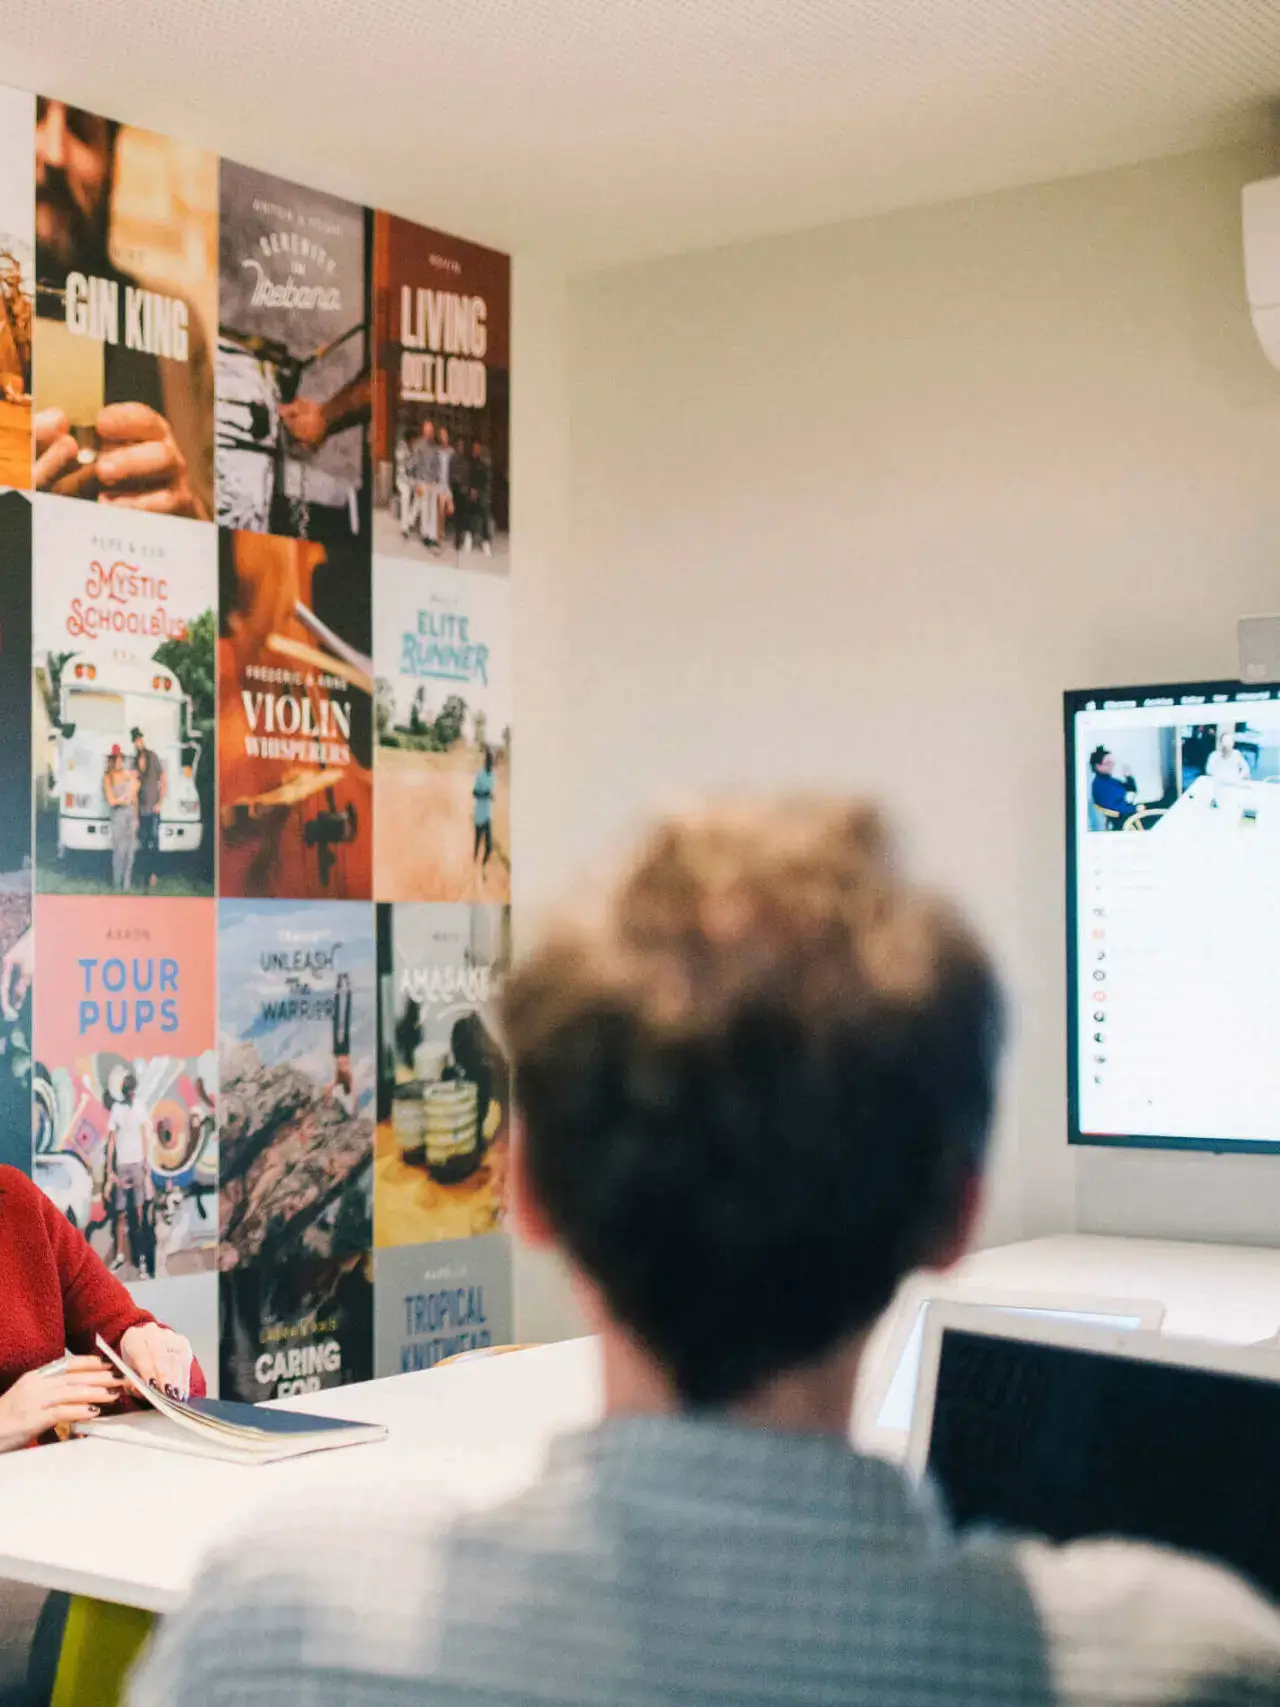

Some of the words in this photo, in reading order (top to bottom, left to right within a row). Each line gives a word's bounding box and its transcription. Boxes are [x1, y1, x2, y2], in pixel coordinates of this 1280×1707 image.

[65, 271, 119, 345] GIN
[125, 285, 189, 362] KING
[400, 284, 487, 358] LIVING
[435, 354, 487, 409] LOUD
[417, 610, 469, 642] ELITE
[400, 632, 490, 688] RUNNER
[241, 690, 351, 740] VIOLIN
[78, 957, 180, 993] TOUR
[79, 999, 180, 1036] PUPS
[255, 1340, 341, 1384] CARING
